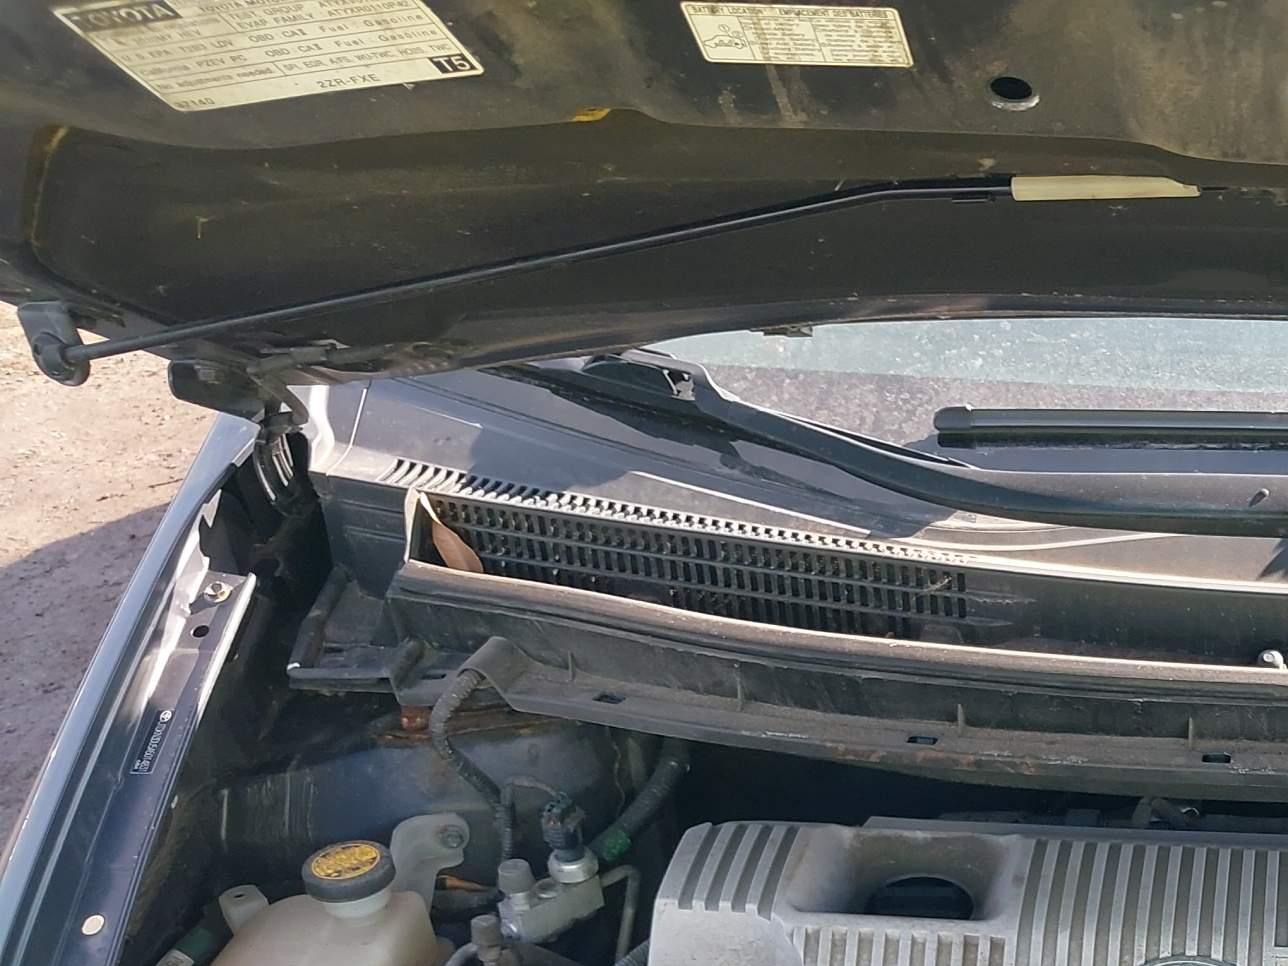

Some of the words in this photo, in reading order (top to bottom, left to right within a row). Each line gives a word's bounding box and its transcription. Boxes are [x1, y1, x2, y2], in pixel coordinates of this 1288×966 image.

[70, 3, 173, 29] TOYOTA
[263, 4, 305, 16] GROUP
[274, 13, 315, 24] FAMILY
[315, 73, 382, 89] 2ZR-FXE
[434, 56, 470, 72] T5
